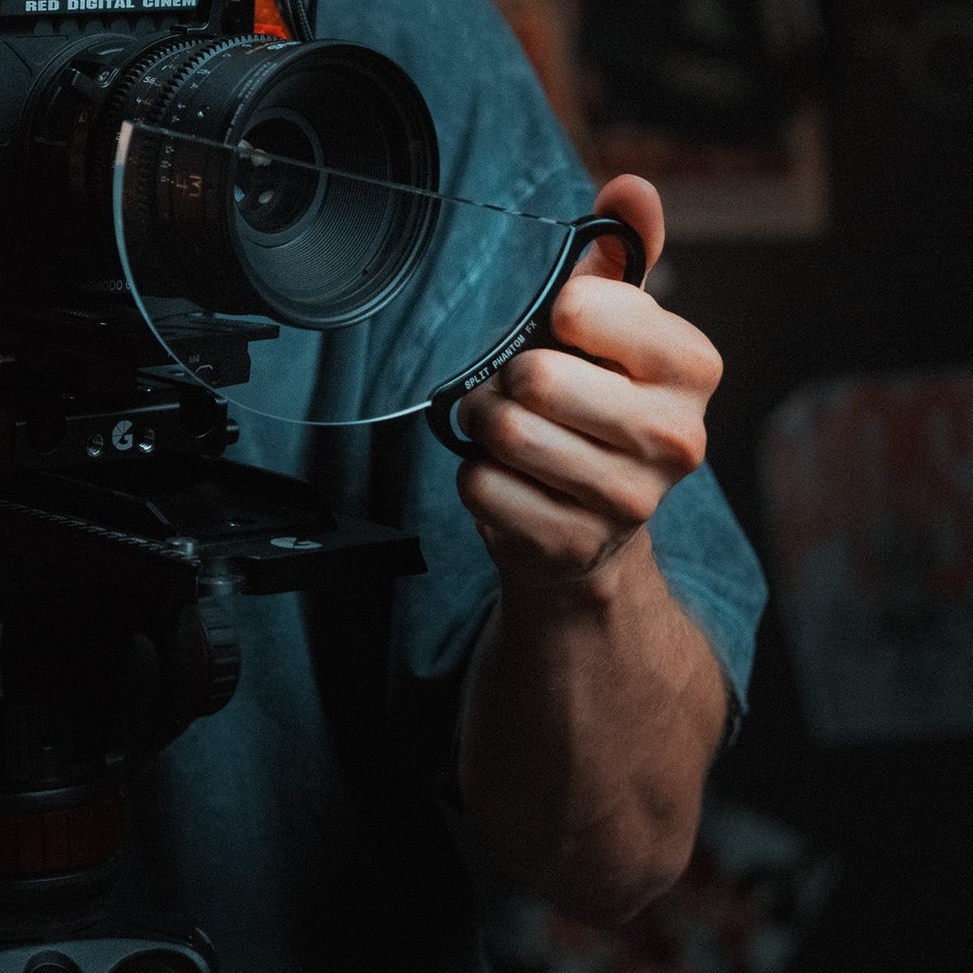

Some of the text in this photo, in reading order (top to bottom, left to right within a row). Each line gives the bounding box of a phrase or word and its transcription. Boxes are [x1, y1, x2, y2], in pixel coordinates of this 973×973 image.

[25, 0, 60, 12] RED
[464, 320, 537, 390] SPLIT PHANTOM FX
